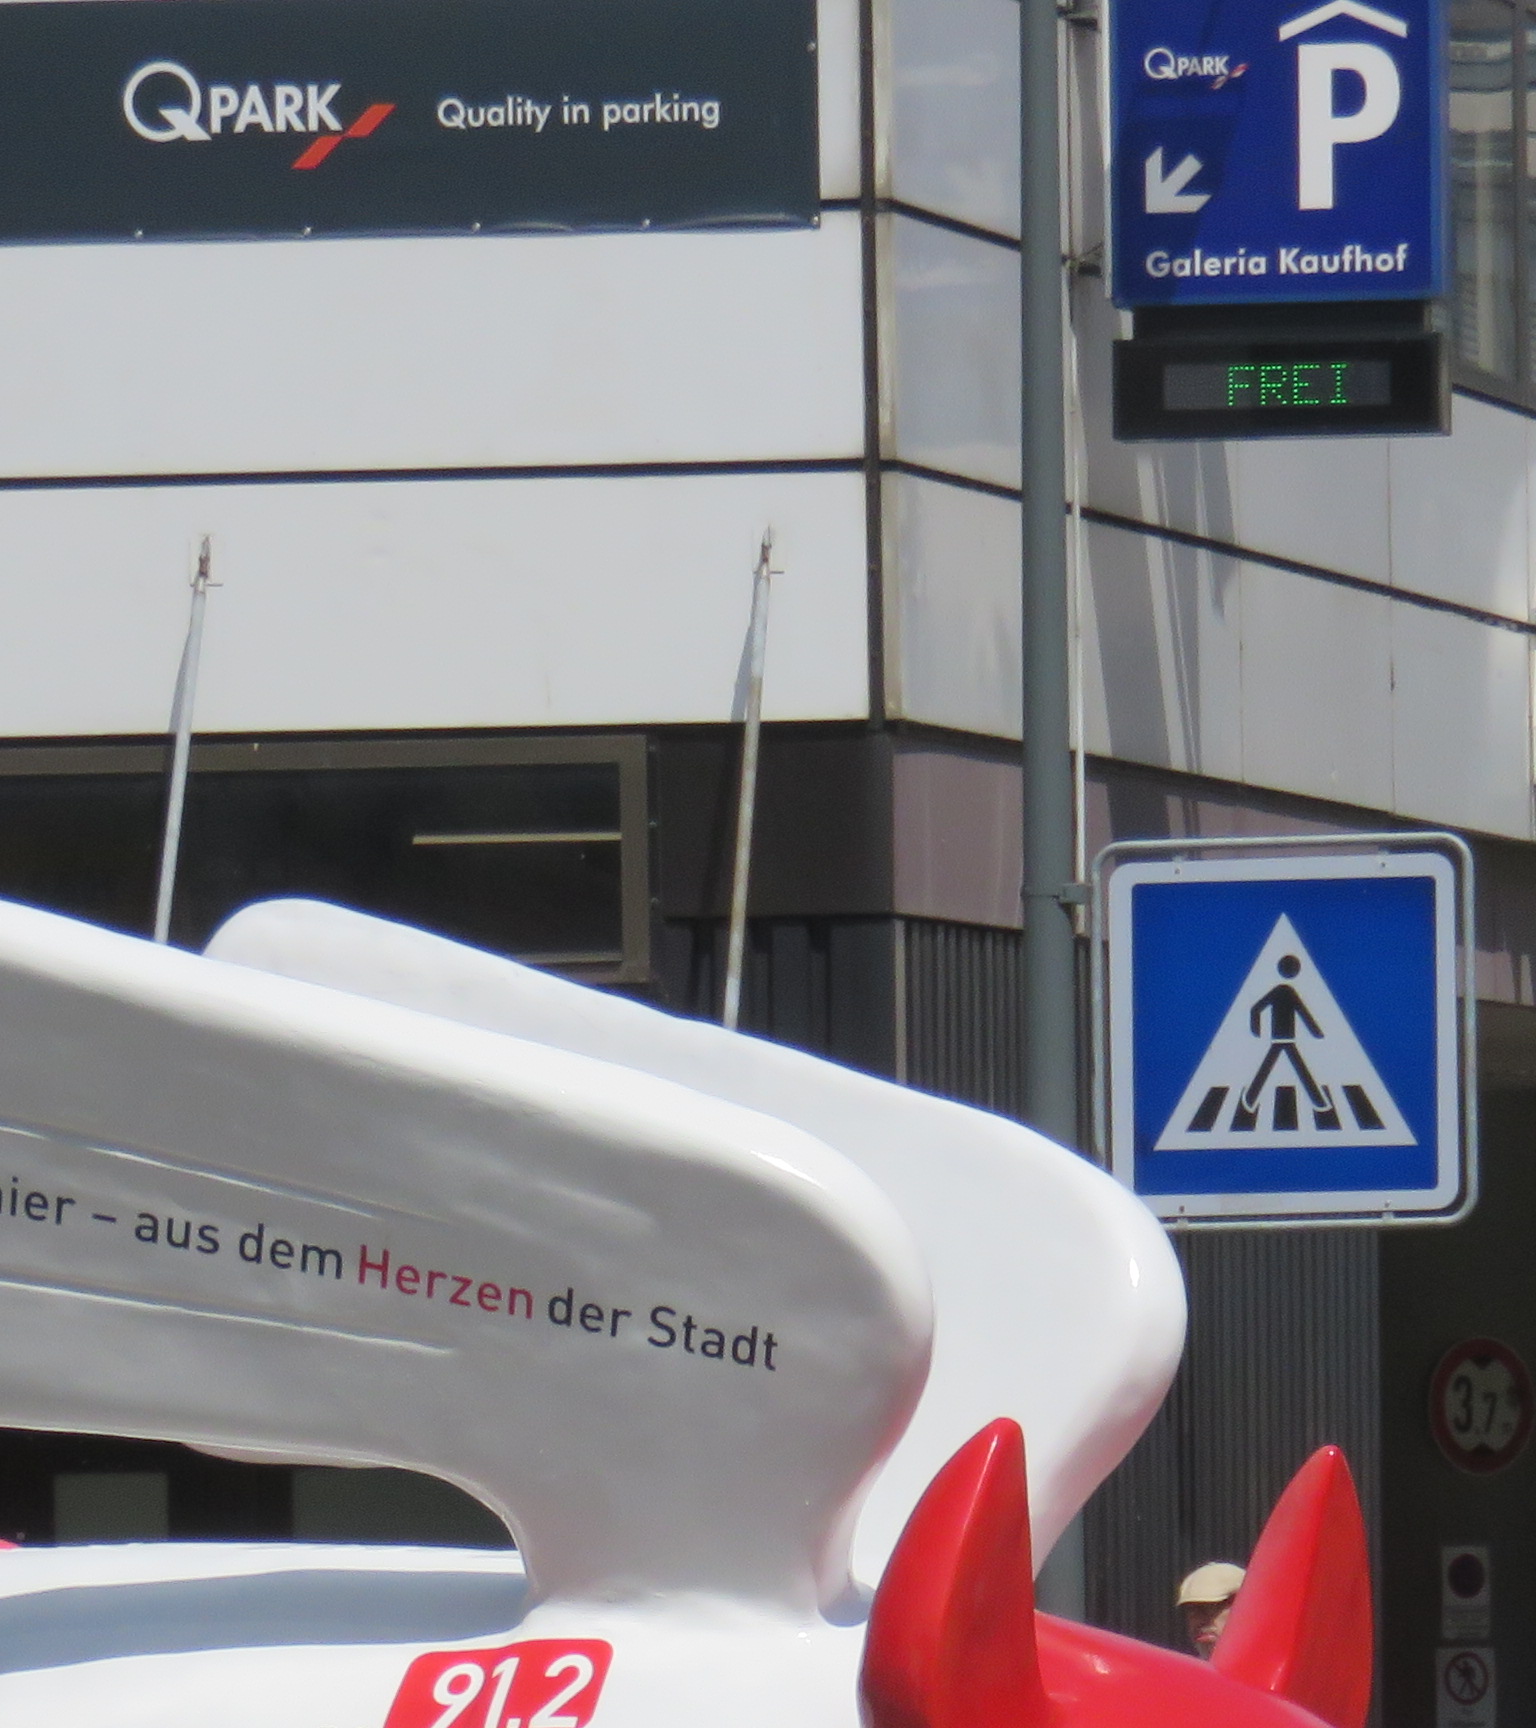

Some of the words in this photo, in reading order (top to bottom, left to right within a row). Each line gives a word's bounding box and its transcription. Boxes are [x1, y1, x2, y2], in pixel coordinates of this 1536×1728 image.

[435, 92, 552, 134] Quality
[561, 92, 591, 126] in
[601, 88, 722, 132] parking
[1298, 42, 1401, 210] P
[1145, 248, 1268, 278] Galeria
[1278, 243, 1410, 276] Kaufhof
[1228, 363, 1348, 407] FREI
[134, 1210, 221, 1255] aus
[238, 1223, 344, 1279] dem
[358, 1245, 534, 1320] Herzen
[548, 1287, 632, 1338] der
[647, 1306, 779, 1372] Stadt
